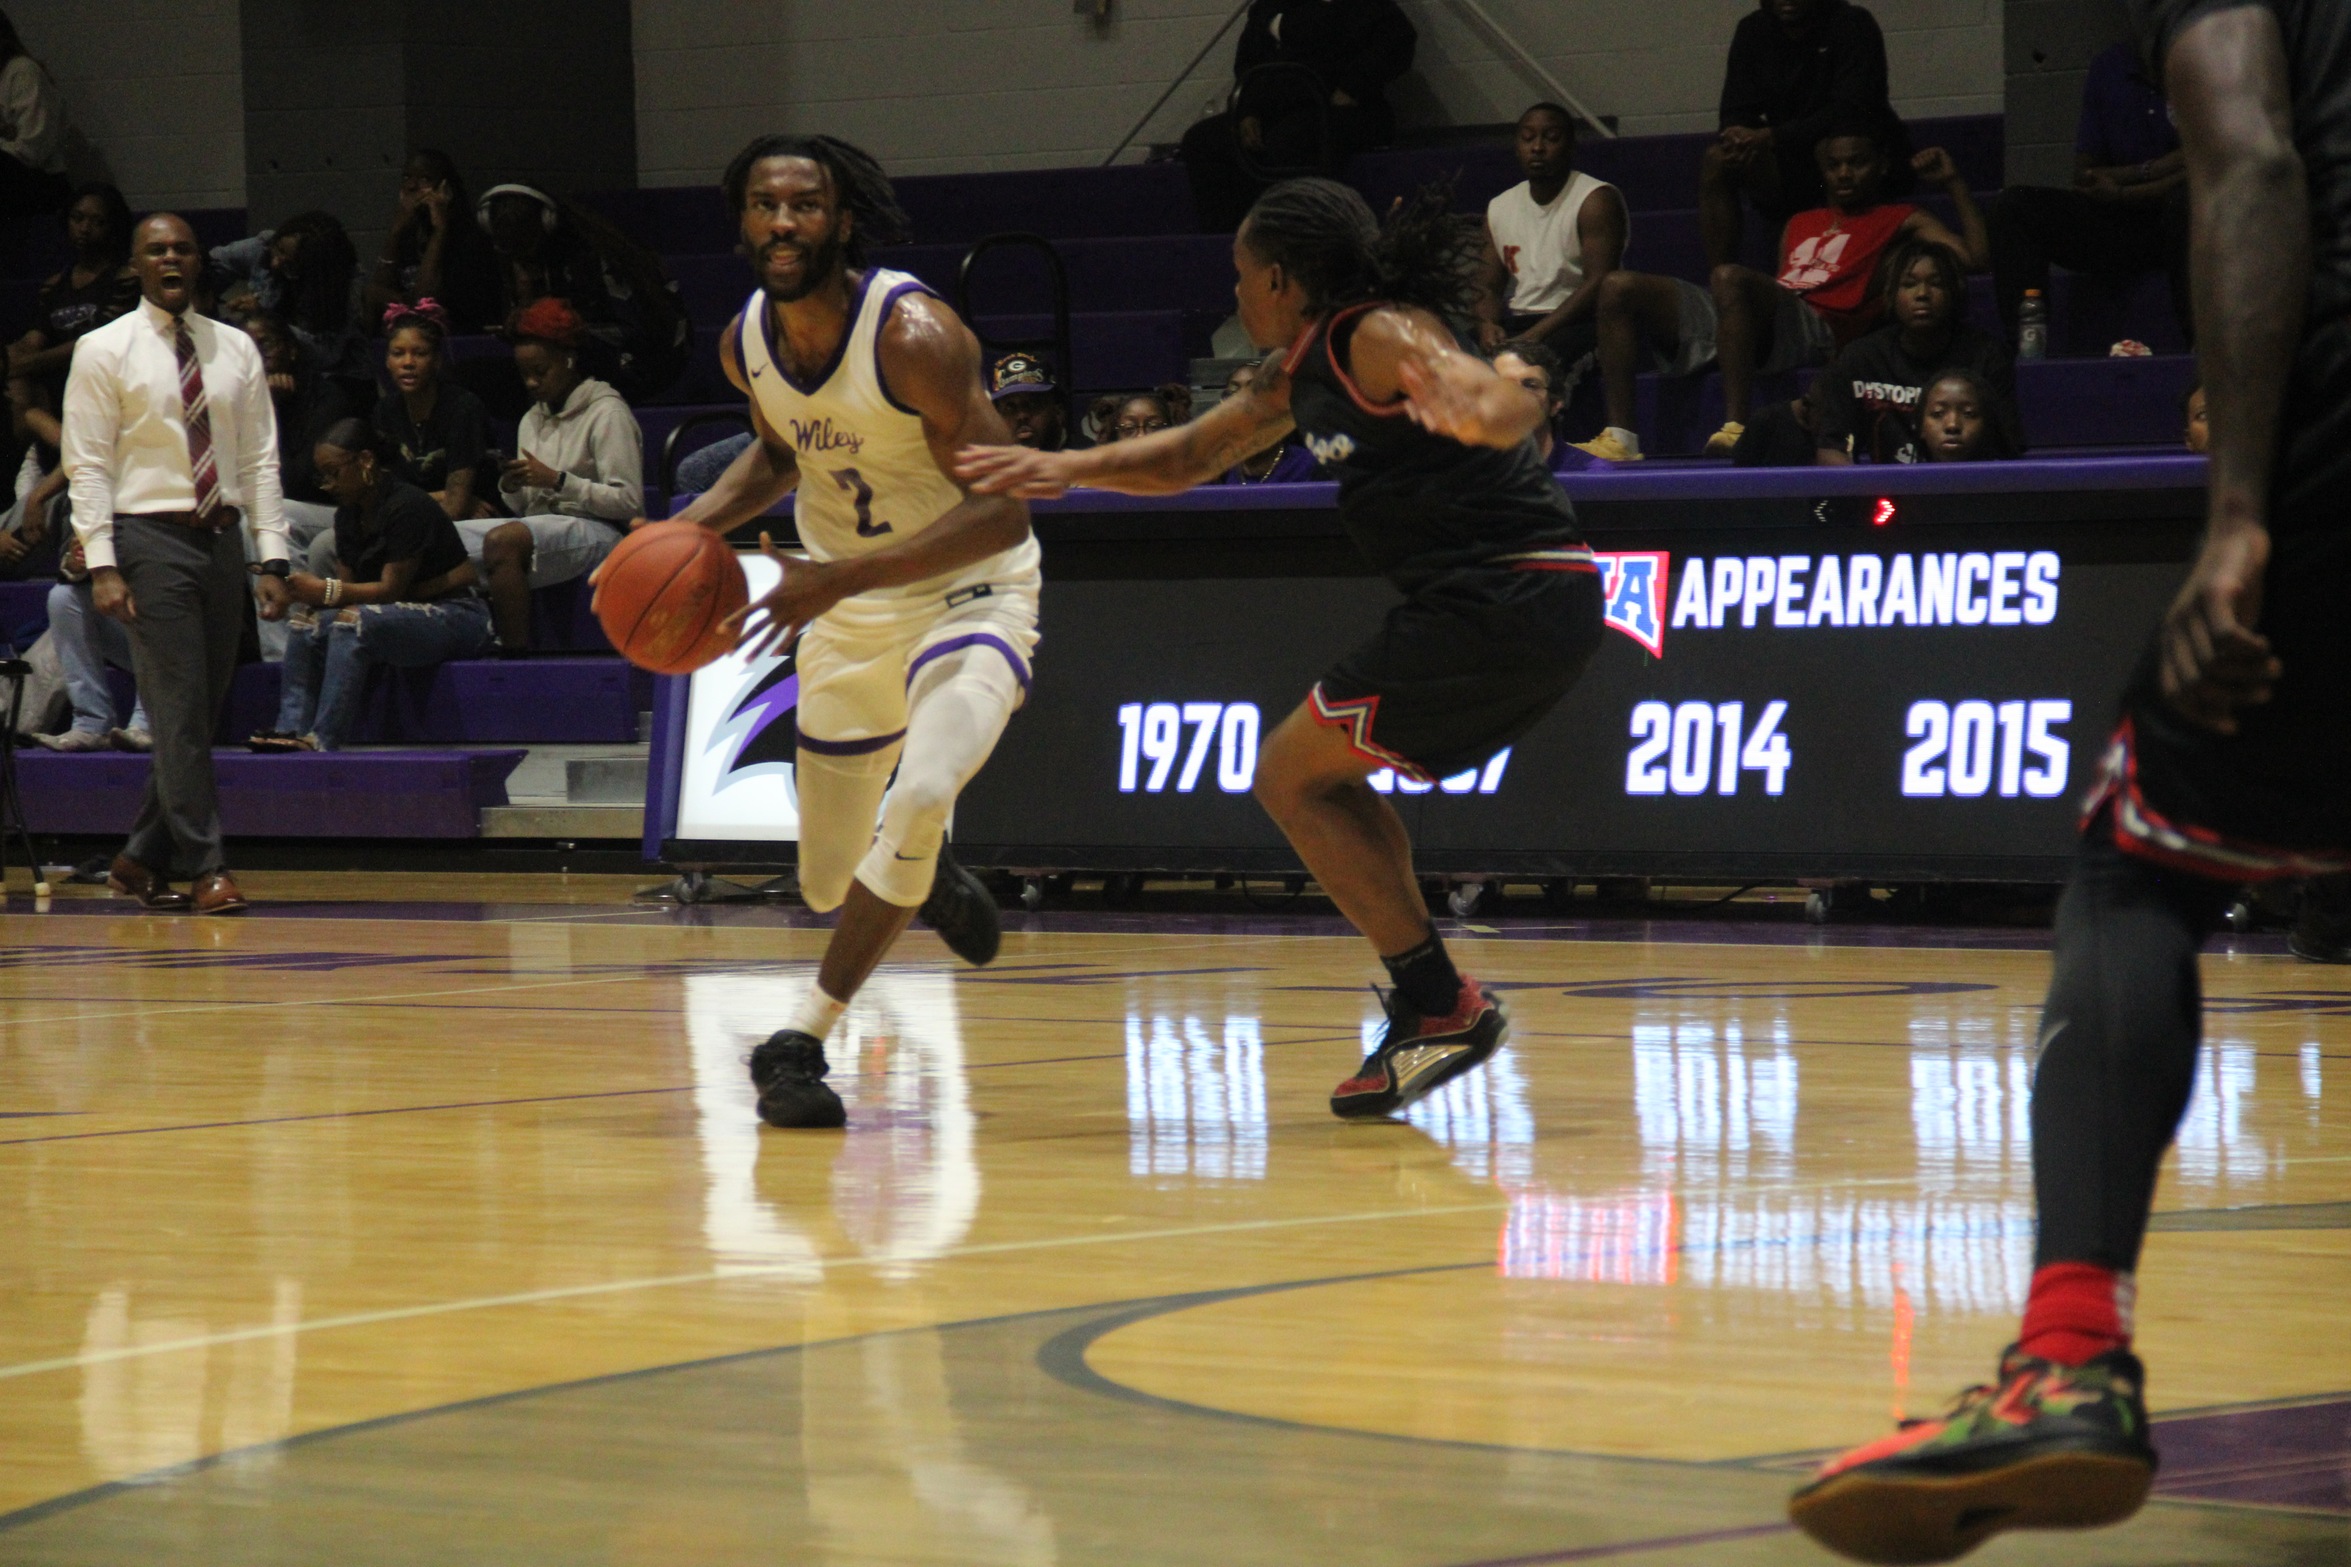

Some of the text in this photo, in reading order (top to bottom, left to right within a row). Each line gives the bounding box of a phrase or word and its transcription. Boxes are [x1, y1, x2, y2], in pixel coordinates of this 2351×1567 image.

[789, 417, 864, 454] Wiley
[828, 467, 893, 537] 2
[1671, 552, 2061, 629] APPEARANCES
[1118, 702, 1261, 793] 1970
[1625, 700, 1792, 796] 2014
[1901, 700, 2072, 797] 2015
